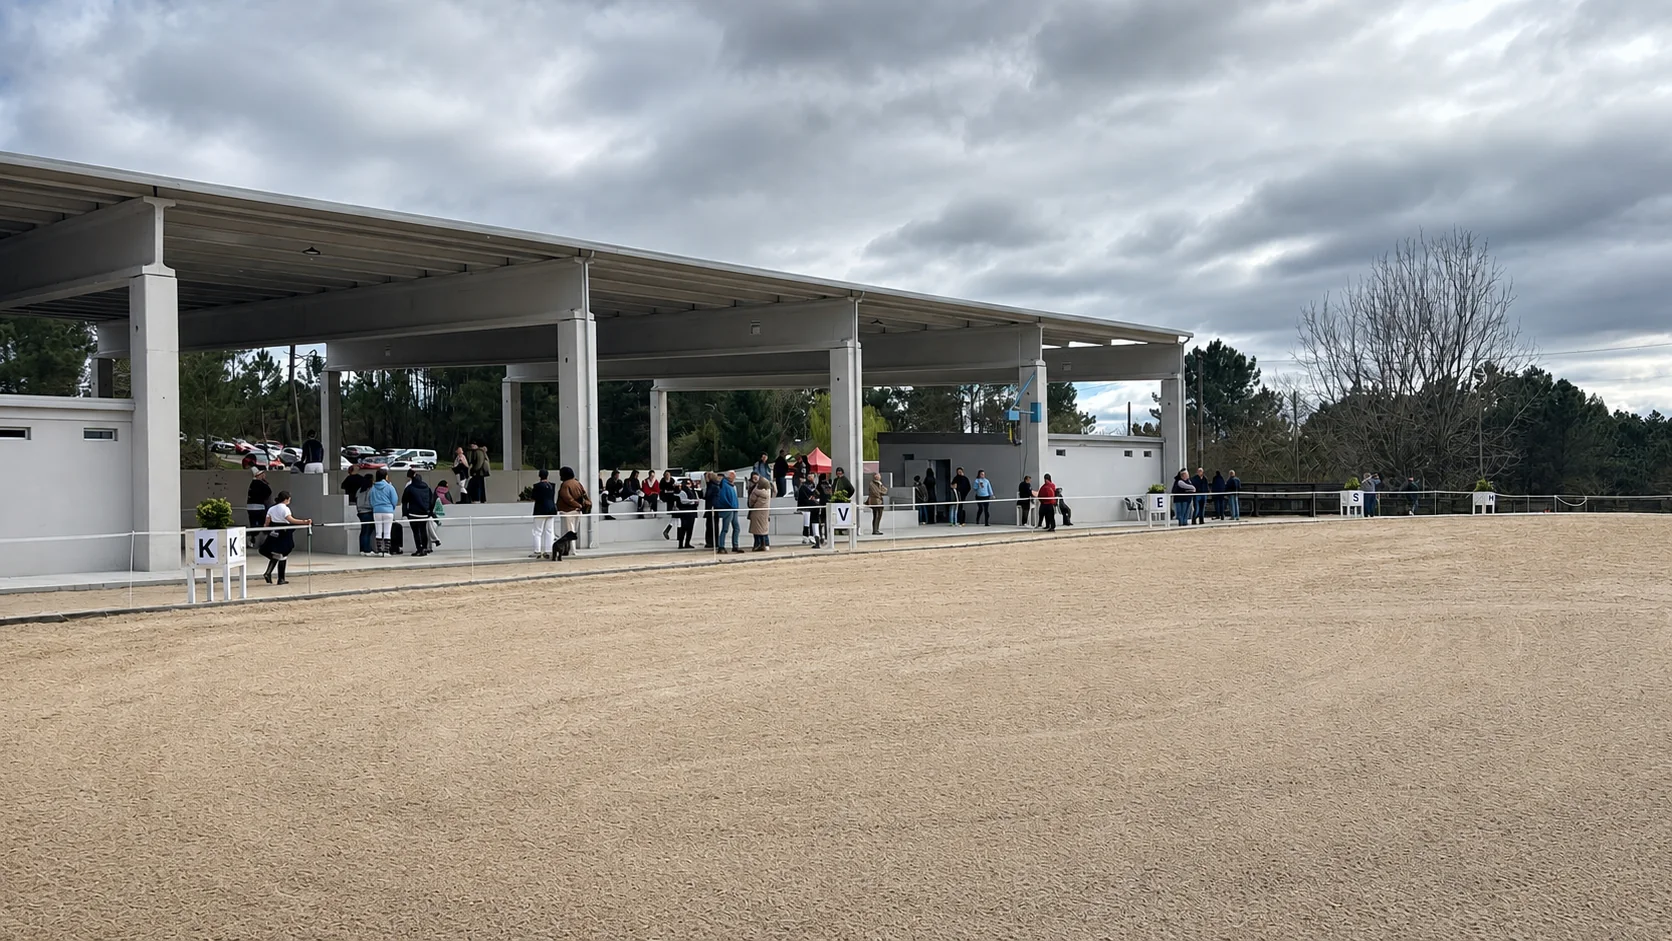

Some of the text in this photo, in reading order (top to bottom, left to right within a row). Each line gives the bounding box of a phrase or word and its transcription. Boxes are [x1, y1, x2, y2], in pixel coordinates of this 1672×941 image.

[1157, 497, 1163, 508] E
[1353, 493, 1359, 502] S
[838, 507, 849, 521] V
[199, 538, 215, 558] K
[229, 537, 238, 557] K
